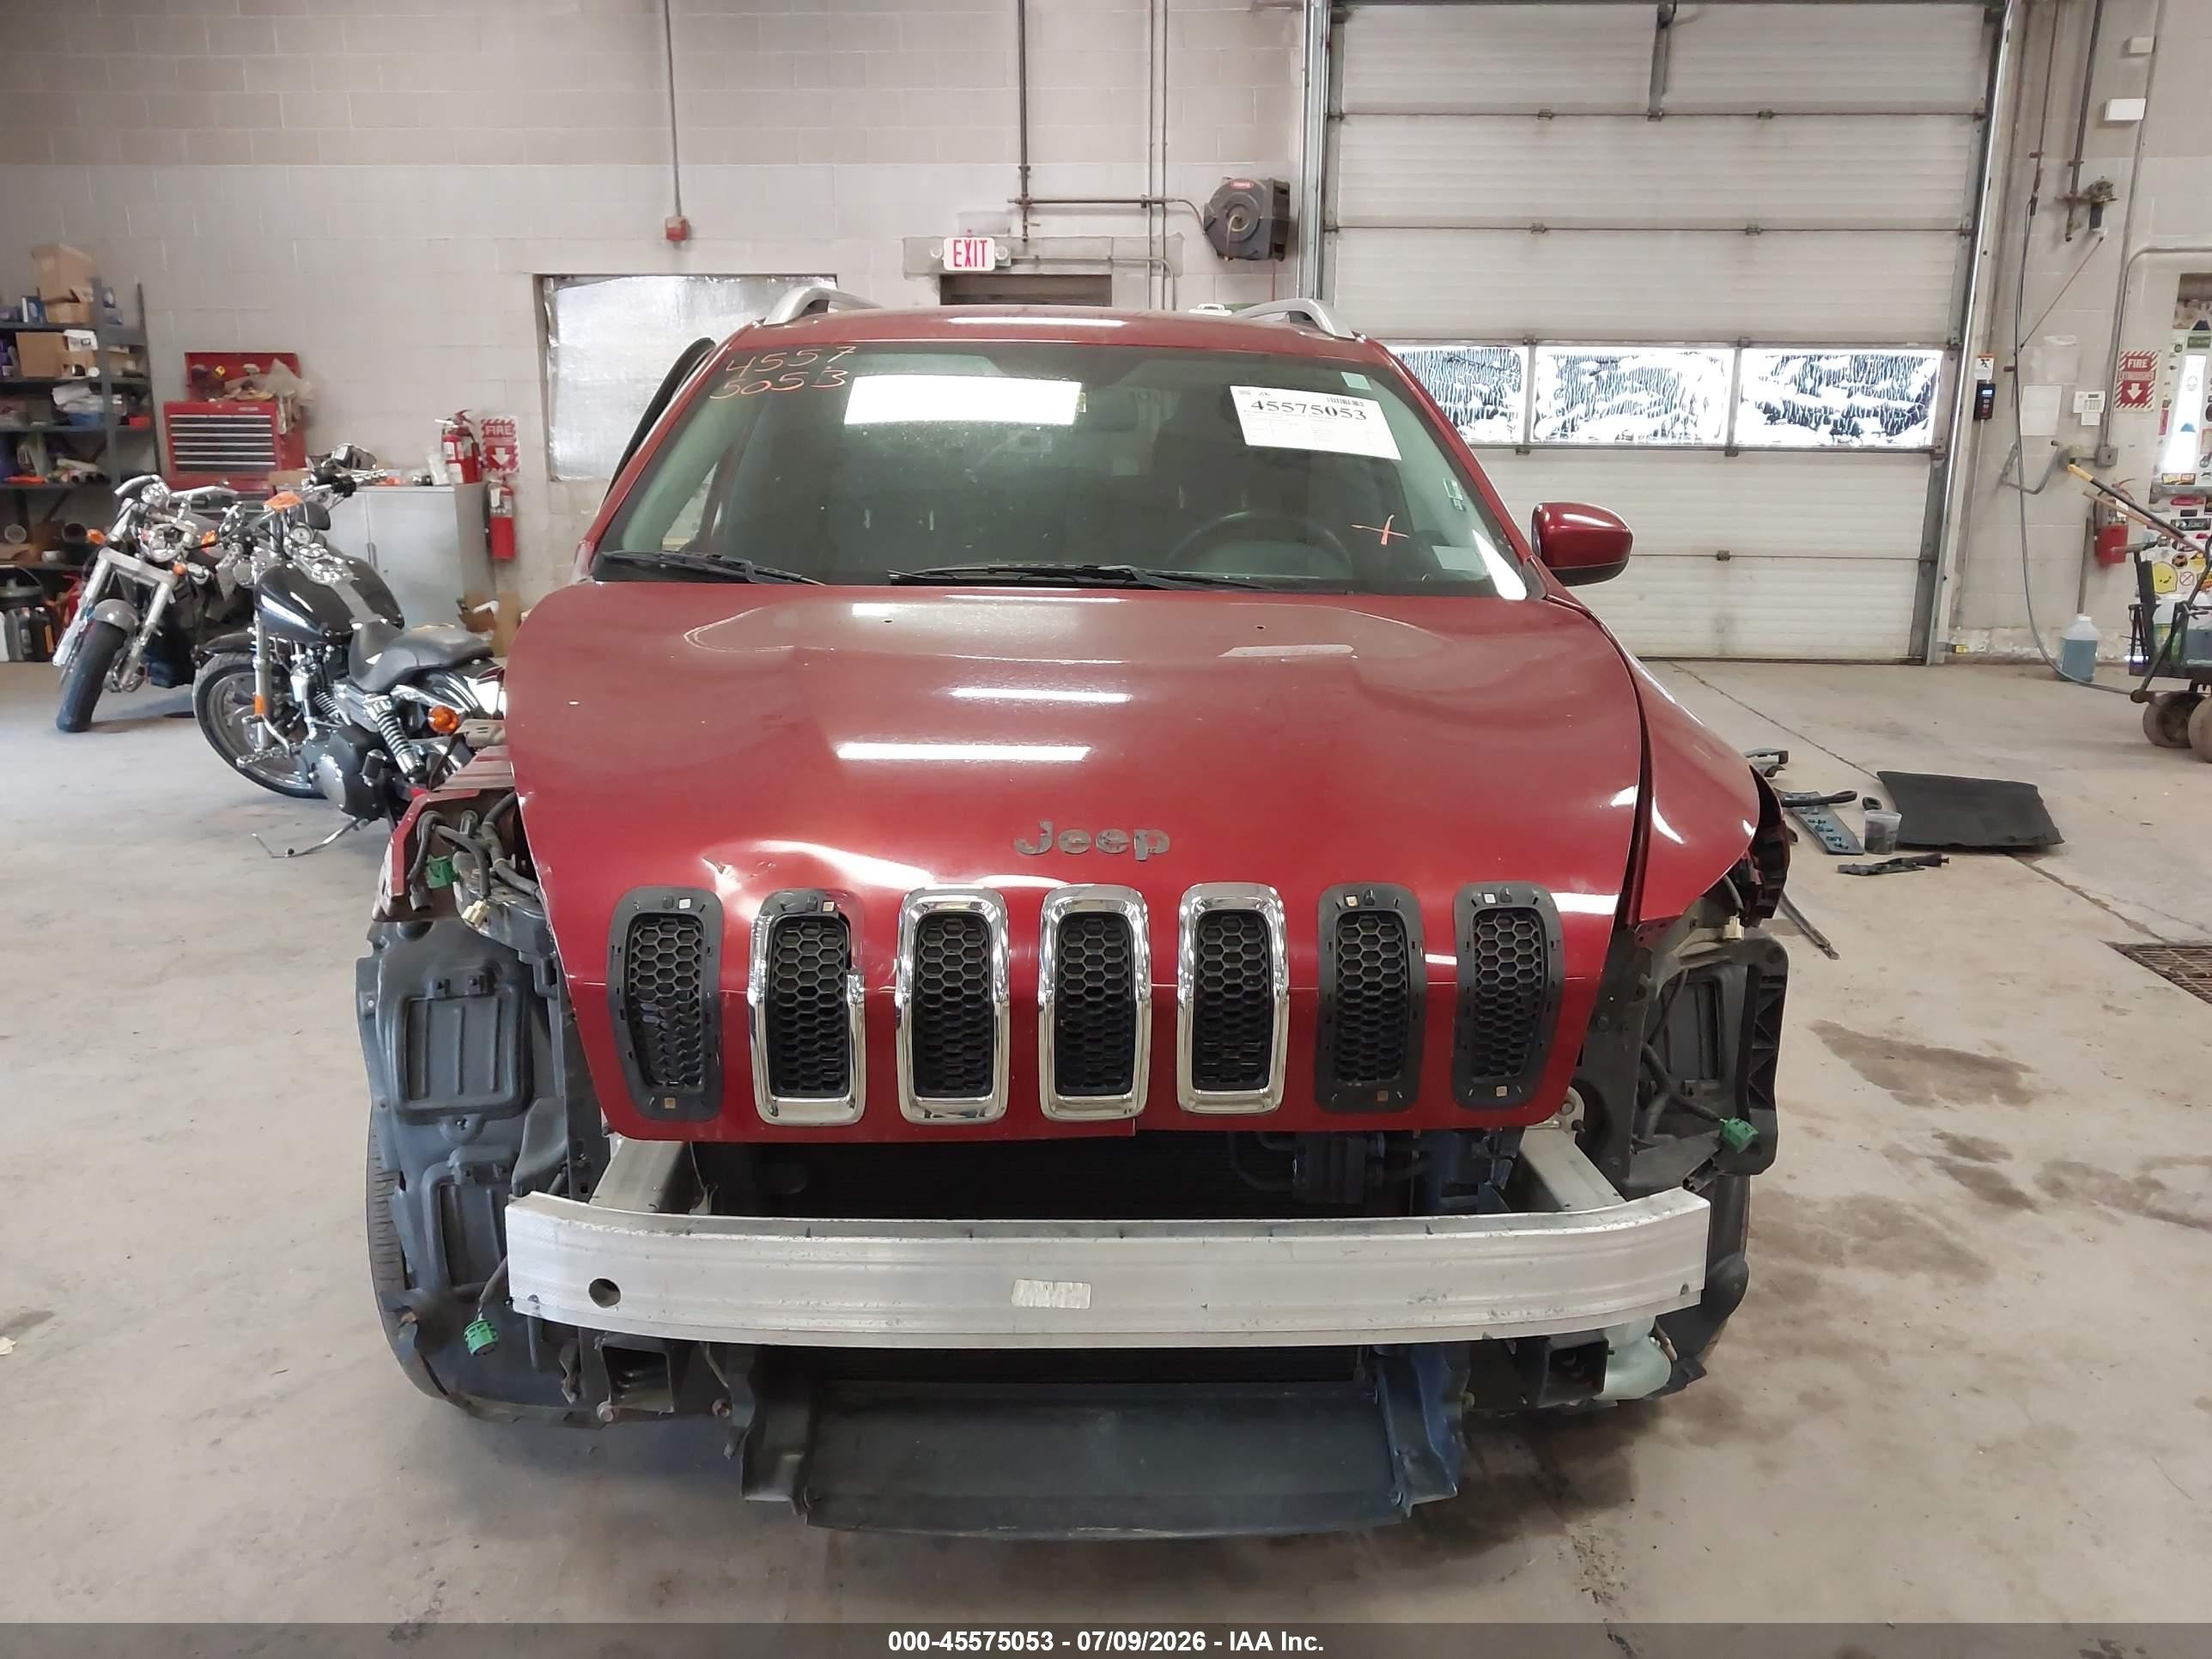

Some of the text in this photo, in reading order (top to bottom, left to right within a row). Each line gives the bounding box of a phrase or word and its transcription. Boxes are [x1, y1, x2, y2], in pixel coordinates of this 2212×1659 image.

[953, 240, 988, 268] EXIT
[726, 346, 857, 379] 4557
[2127, 358, 2148, 369] FIRE
[709, 366, 849, 399] 5053
[1250, 399, 1368, 422] 45575053
[484, 425, 514, 436] FIRE
[1013, 818, 1171, 861] Jeep
